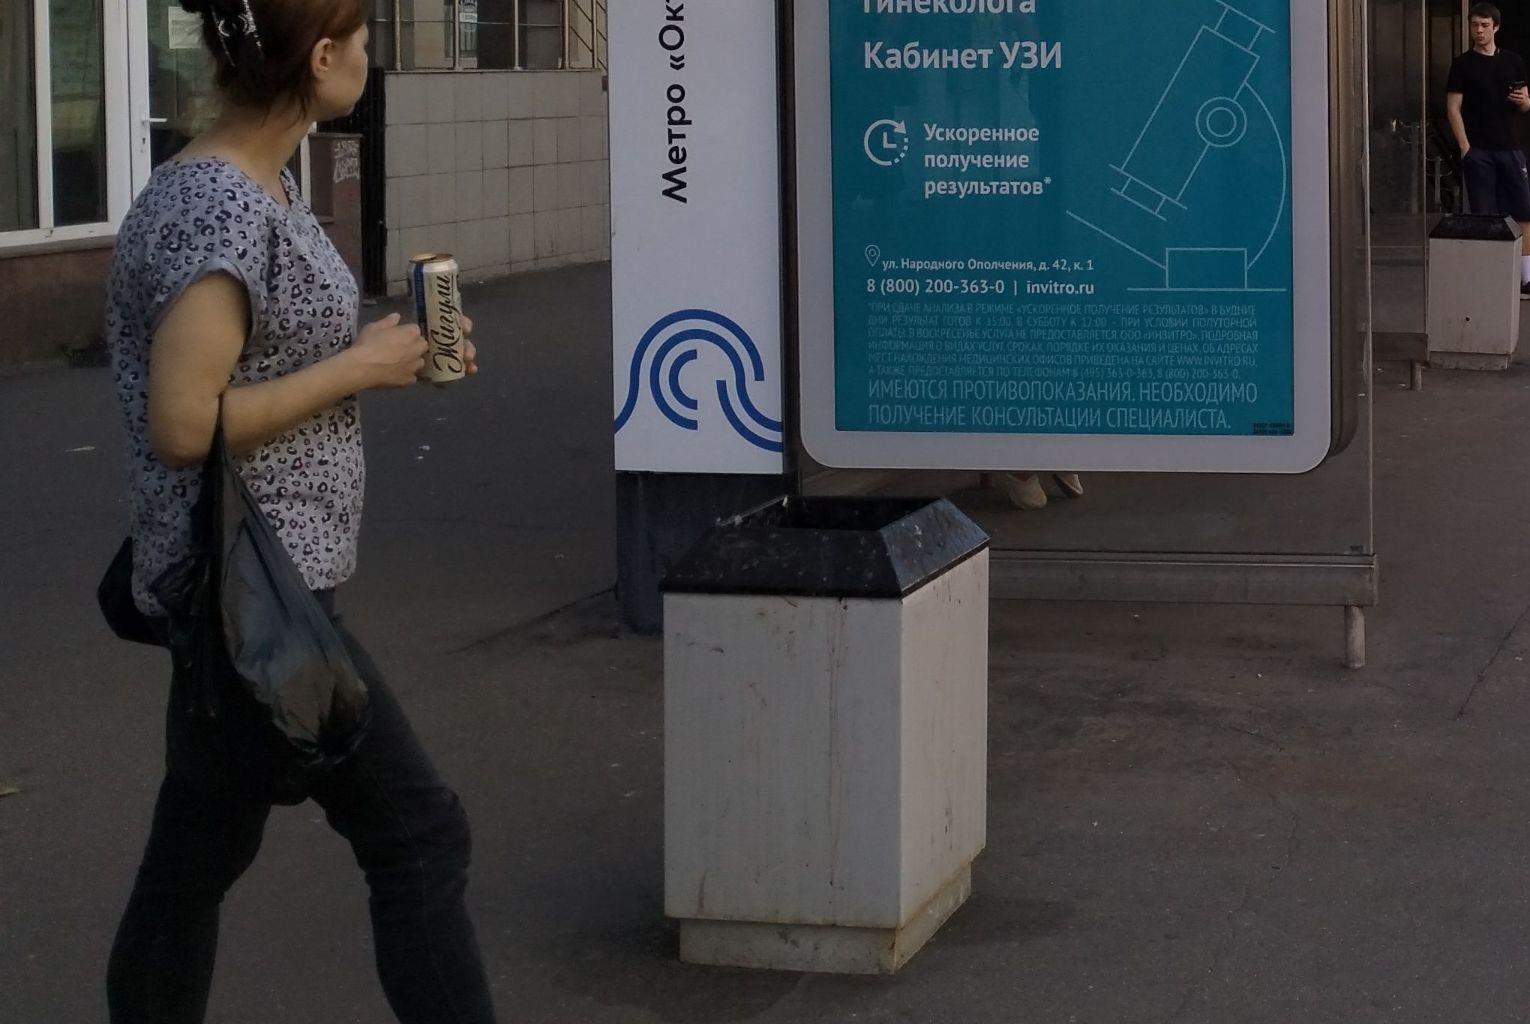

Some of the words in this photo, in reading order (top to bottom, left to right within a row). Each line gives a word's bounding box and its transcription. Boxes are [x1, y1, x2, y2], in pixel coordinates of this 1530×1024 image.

[863, 41, 994, 70] Кабинет
[1000, 41, 1062, 70] УЗИ
[661, 83, 693, 204] Метро
[923, 122, 1040, 147] Ускоренное
[923, 152, 1030, 171] получение
[882, 259, 898, 273] ул.
[900, 257, 965, 272] Народного
[966, 258, 1037, 273] Ополчения,
[1051, 258, 1072, 273] 42,
[1086, 257, 1095, 271] 1
[866, 279, 876, 294] 8
[879, 279, 920, 296] (800)
[924, 279, 1005, 295] 200-363-0
[1025, 279, 1095, 296] invitro.ru
[867, 378, 948, 400] ИМЕЮТСЯ
[952, 379, 1136, 402] ПРОТИВОПОКАЗАНИЯ.
[1139, 382, 1258, 405] НЕОБХОДИМО
[867, 404, 966, 425] ПОЛУЧЕНИЕ
[971, 406, 1101, 429] КОНСУЛЬТАЦИИ
[1106, 407, 1232, 430] СПЕЦИАЛИСТА.
